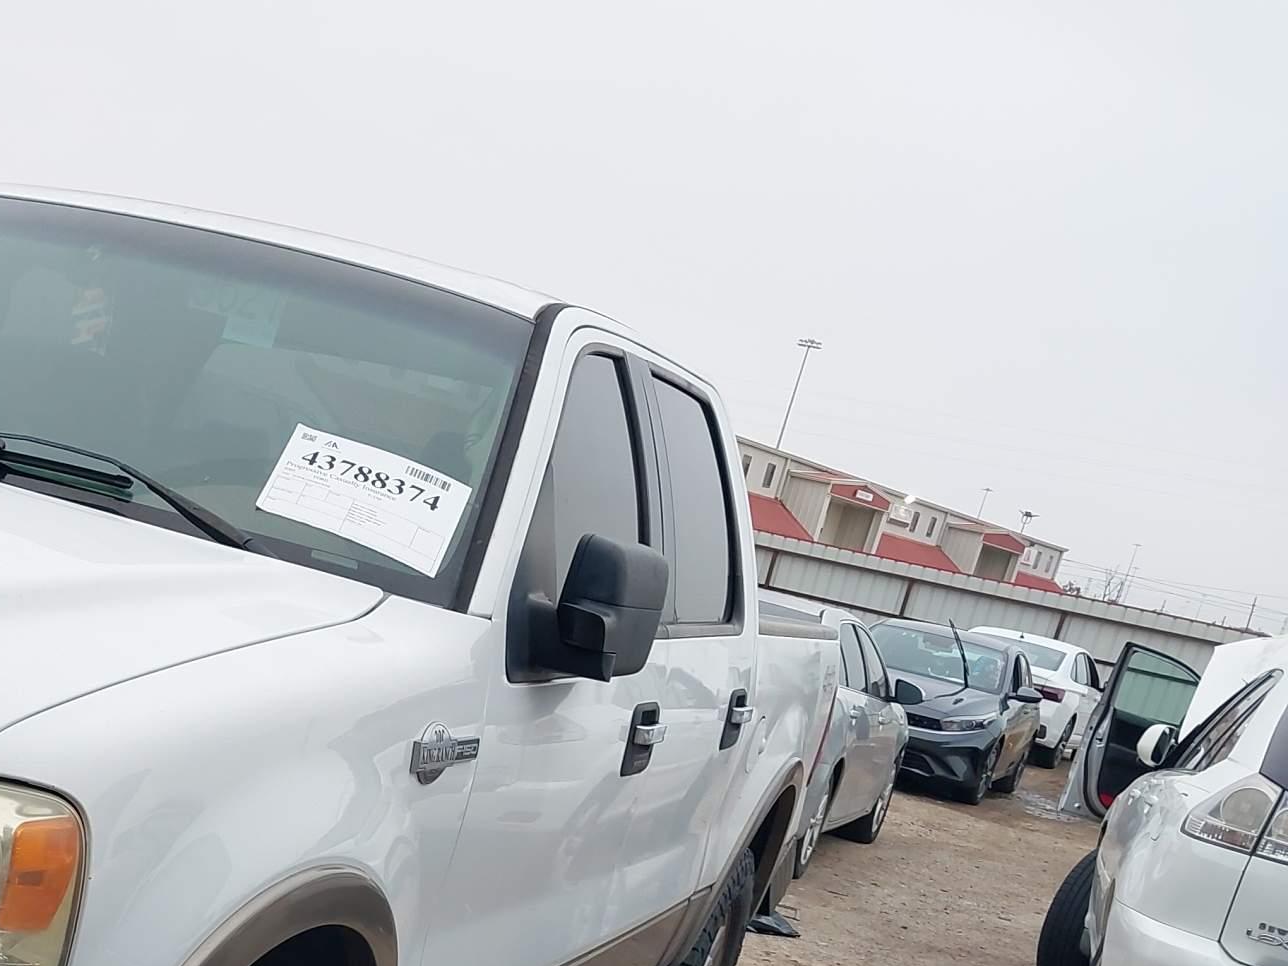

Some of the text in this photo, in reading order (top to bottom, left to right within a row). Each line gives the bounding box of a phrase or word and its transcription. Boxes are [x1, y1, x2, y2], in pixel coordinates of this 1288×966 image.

[286, 460, 328, 478] Progressive
[362, 483, 397, 501] Insurance
[301, 451, 441, 512] 43788374
